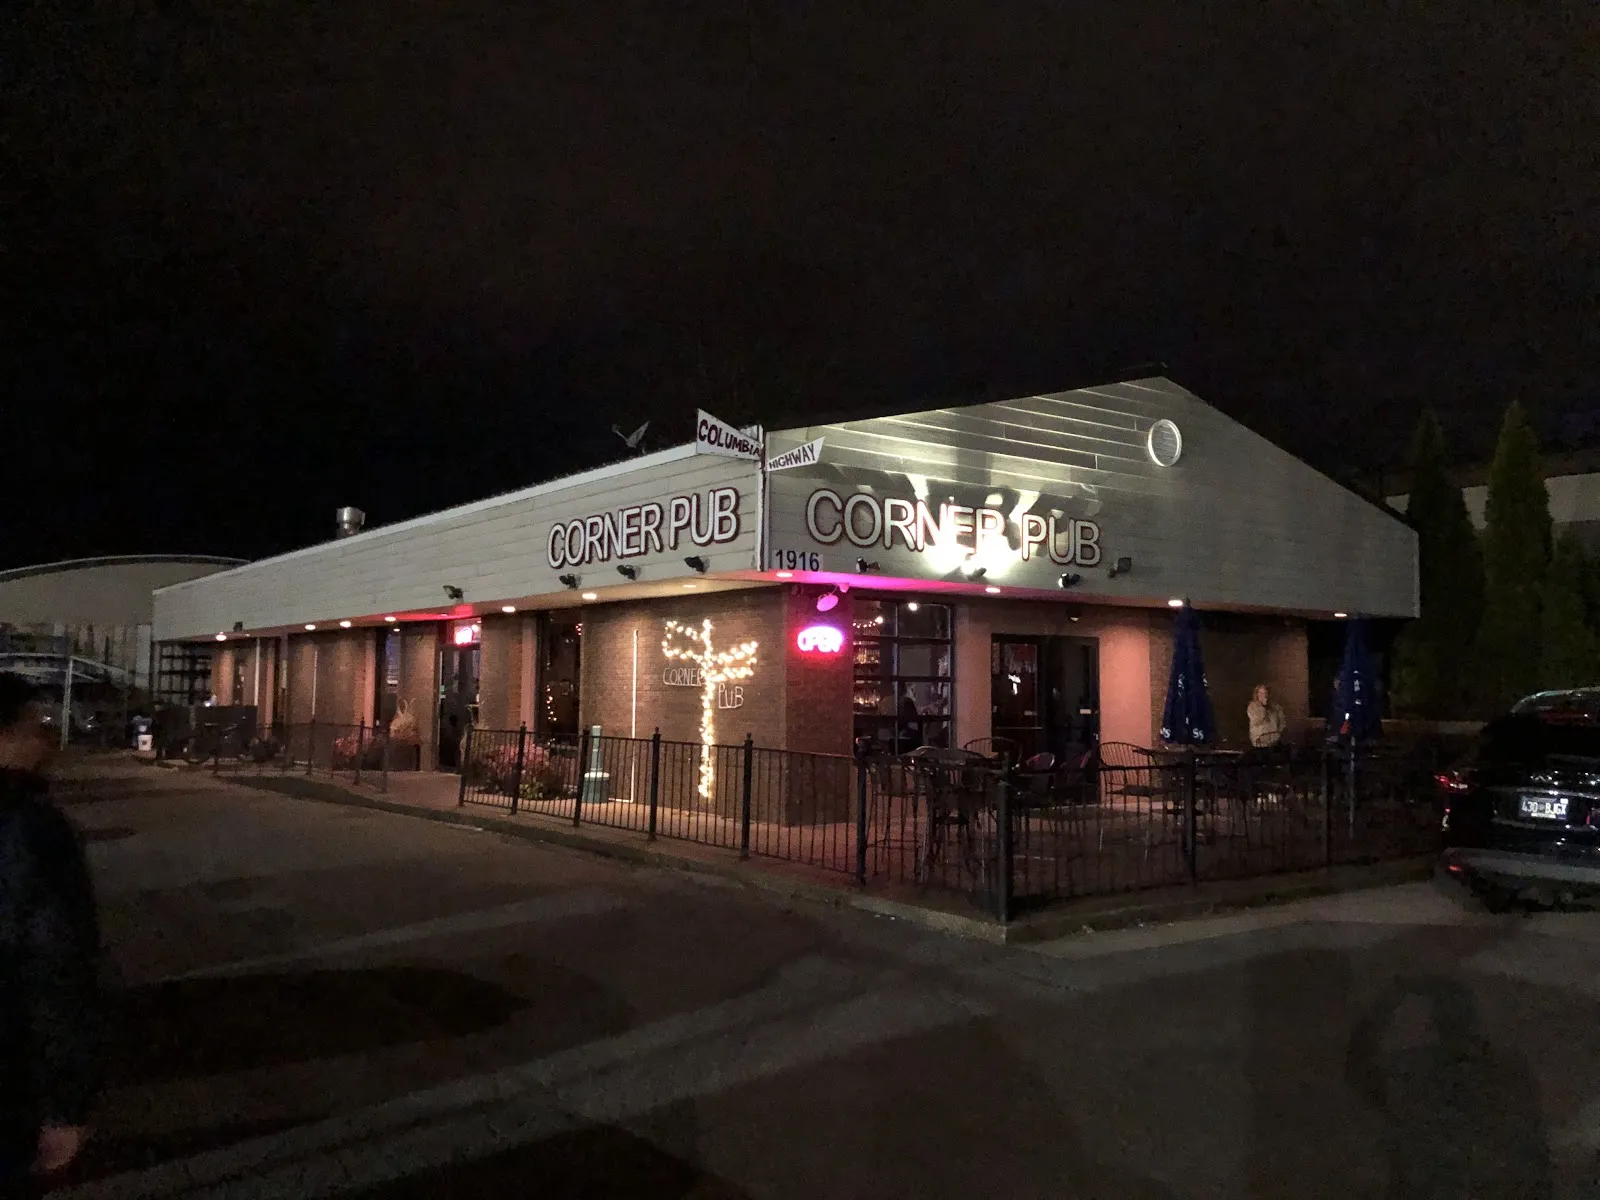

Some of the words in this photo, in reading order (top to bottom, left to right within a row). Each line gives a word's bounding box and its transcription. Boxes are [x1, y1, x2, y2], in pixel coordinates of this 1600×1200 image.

[698, 419, 761, 456] COLUMBIA
[768, 443, 816, 469] HIGHWAY
[548, 502, 663, 569] CORNER
[669, 487, 741, 550] PUB
[806, 488, 1006, 555] CORNER
[1021, 512, 1101, 566] PUB
[775, 550, 820, 572] 1916
[662, 667, 703, 687] CORNER
[718, 683, 744, 709] PUB
